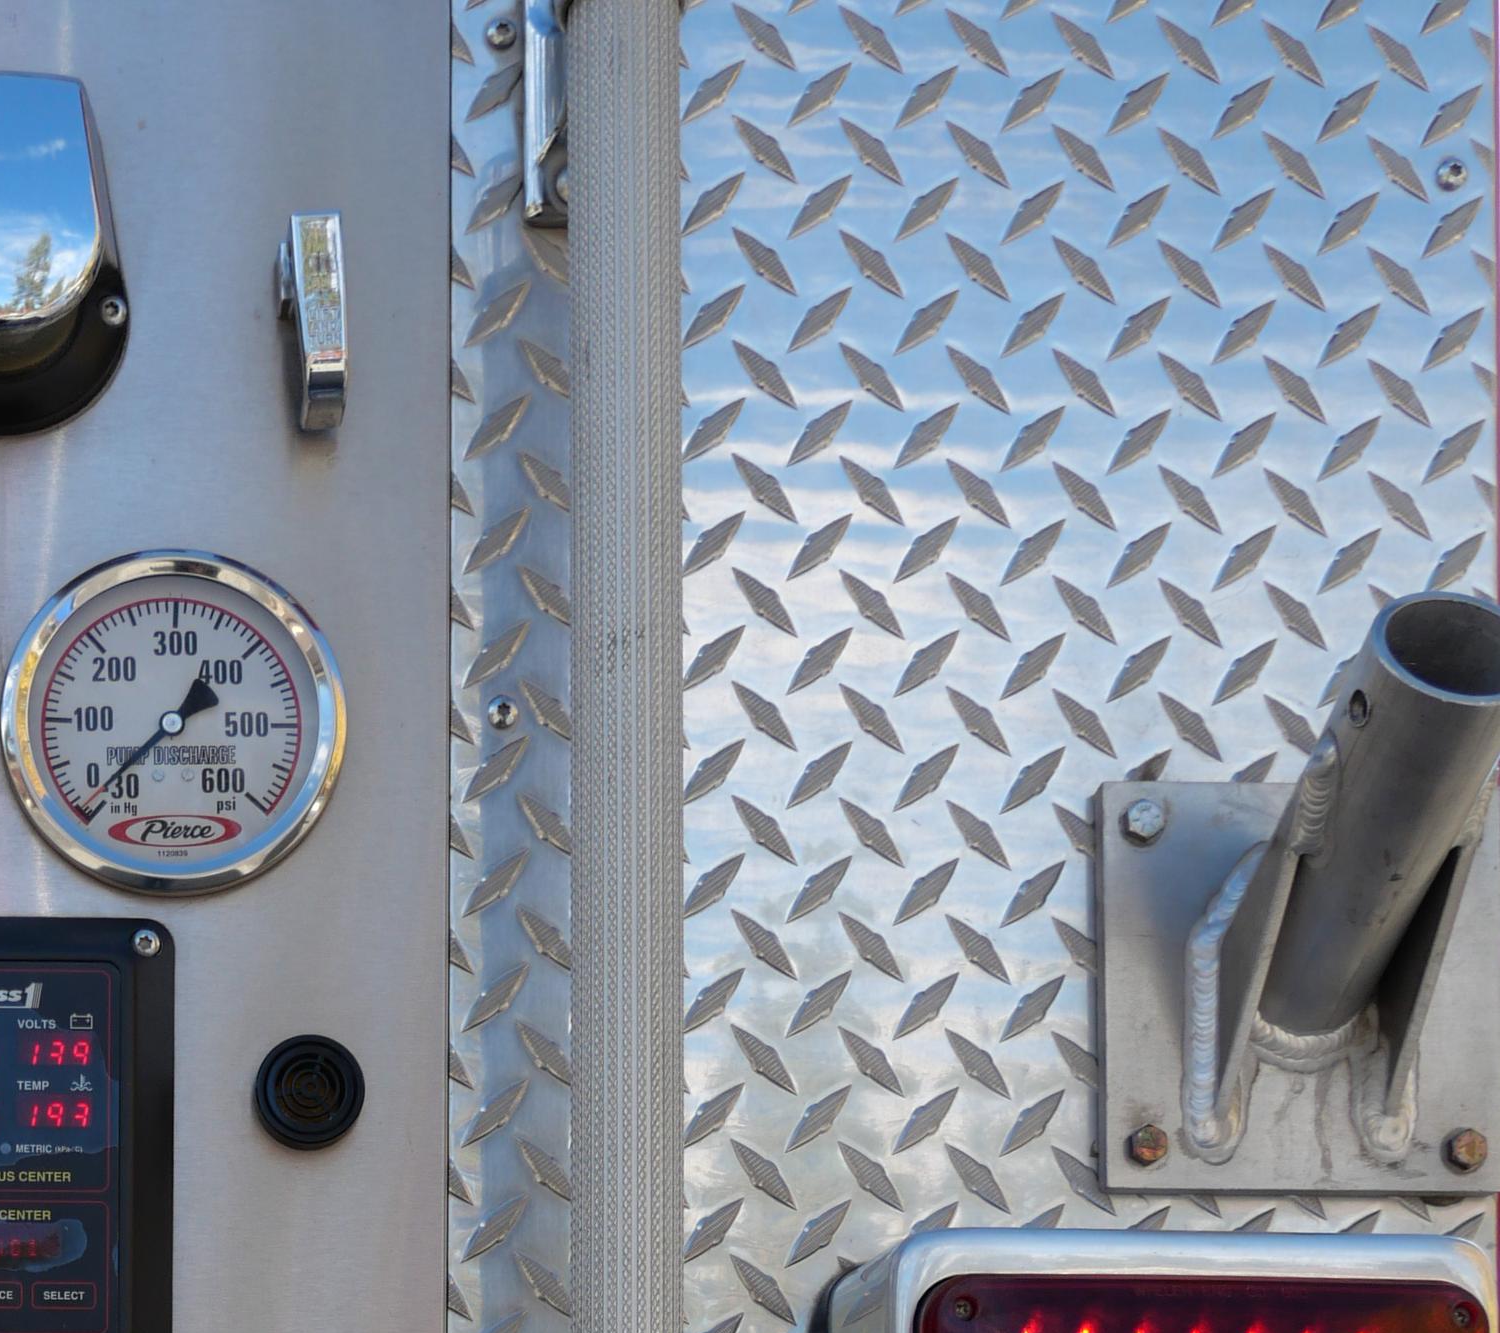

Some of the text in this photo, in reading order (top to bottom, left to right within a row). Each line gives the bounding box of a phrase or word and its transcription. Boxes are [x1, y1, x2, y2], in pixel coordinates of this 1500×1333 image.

[153, 631, 198, 656] 300
[92, 656, 136, 682] 200
[199, 659, 243, 685] 400
[74, 706, 114, 732] 100
[225, 712, 269, 737] 500
[153, 745, 236, 765] DISCHARGE
[86, 762, 100, 788] 0
[202, 767, 245, 794] 600
[124, 801, 138, 816] Hg
[217, 797, 236, 814] psi
[140, 819, 215, 842] Pierce
[17, 1019, 56, 1030] VOLTS
[17, 1080, 50, 1091] TEMP
[16, 1144, 52, 1155] METRIC
[19, 1171, 72, 1183] CENTER
[43, 1291, 85, 1301] SELECT
